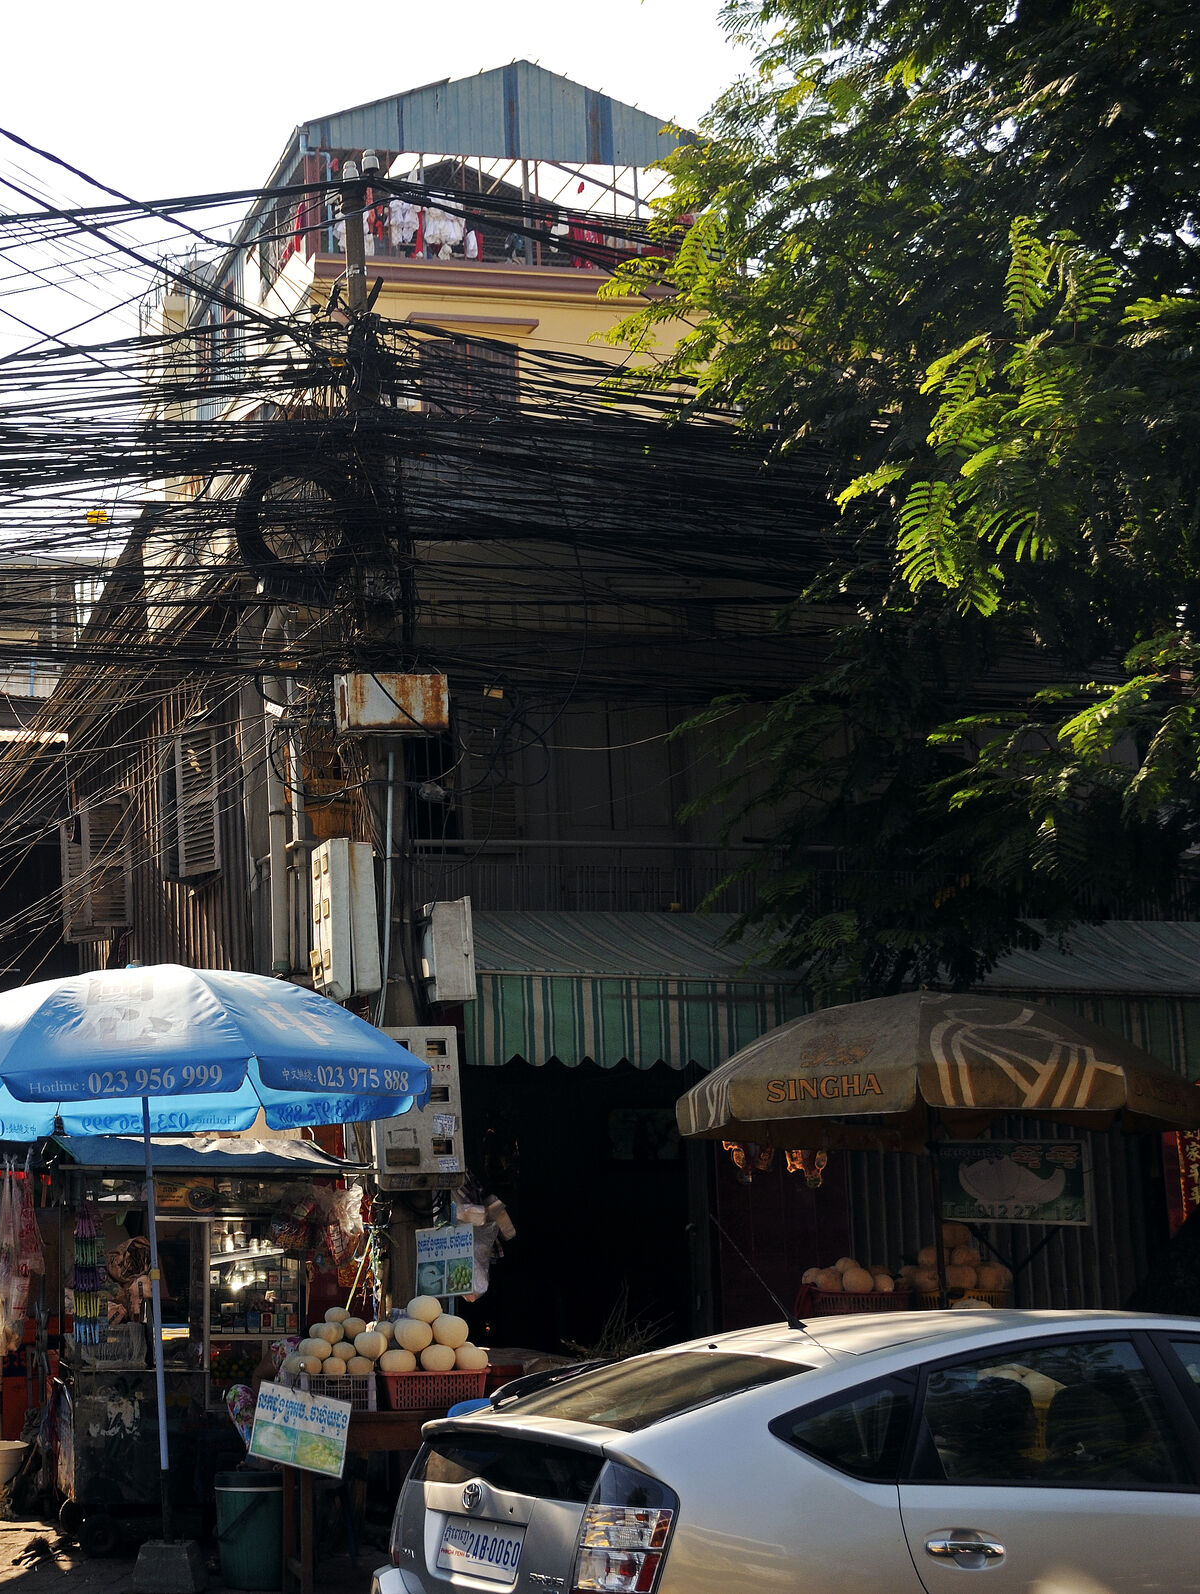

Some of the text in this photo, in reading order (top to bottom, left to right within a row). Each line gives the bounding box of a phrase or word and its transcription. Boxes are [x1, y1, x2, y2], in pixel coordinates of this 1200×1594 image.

[88, 1071, 129, 1094] 023
[135, 1066, 175, 1091] 956
[182, 1064, 222, 1088] 999
[317, 1065, 345, 1088] 023
[349, 1066, 380, 1089] 975
[383, 1069, 409, 1092] 888
[766, 1073, 884, 1103] SINGHA
